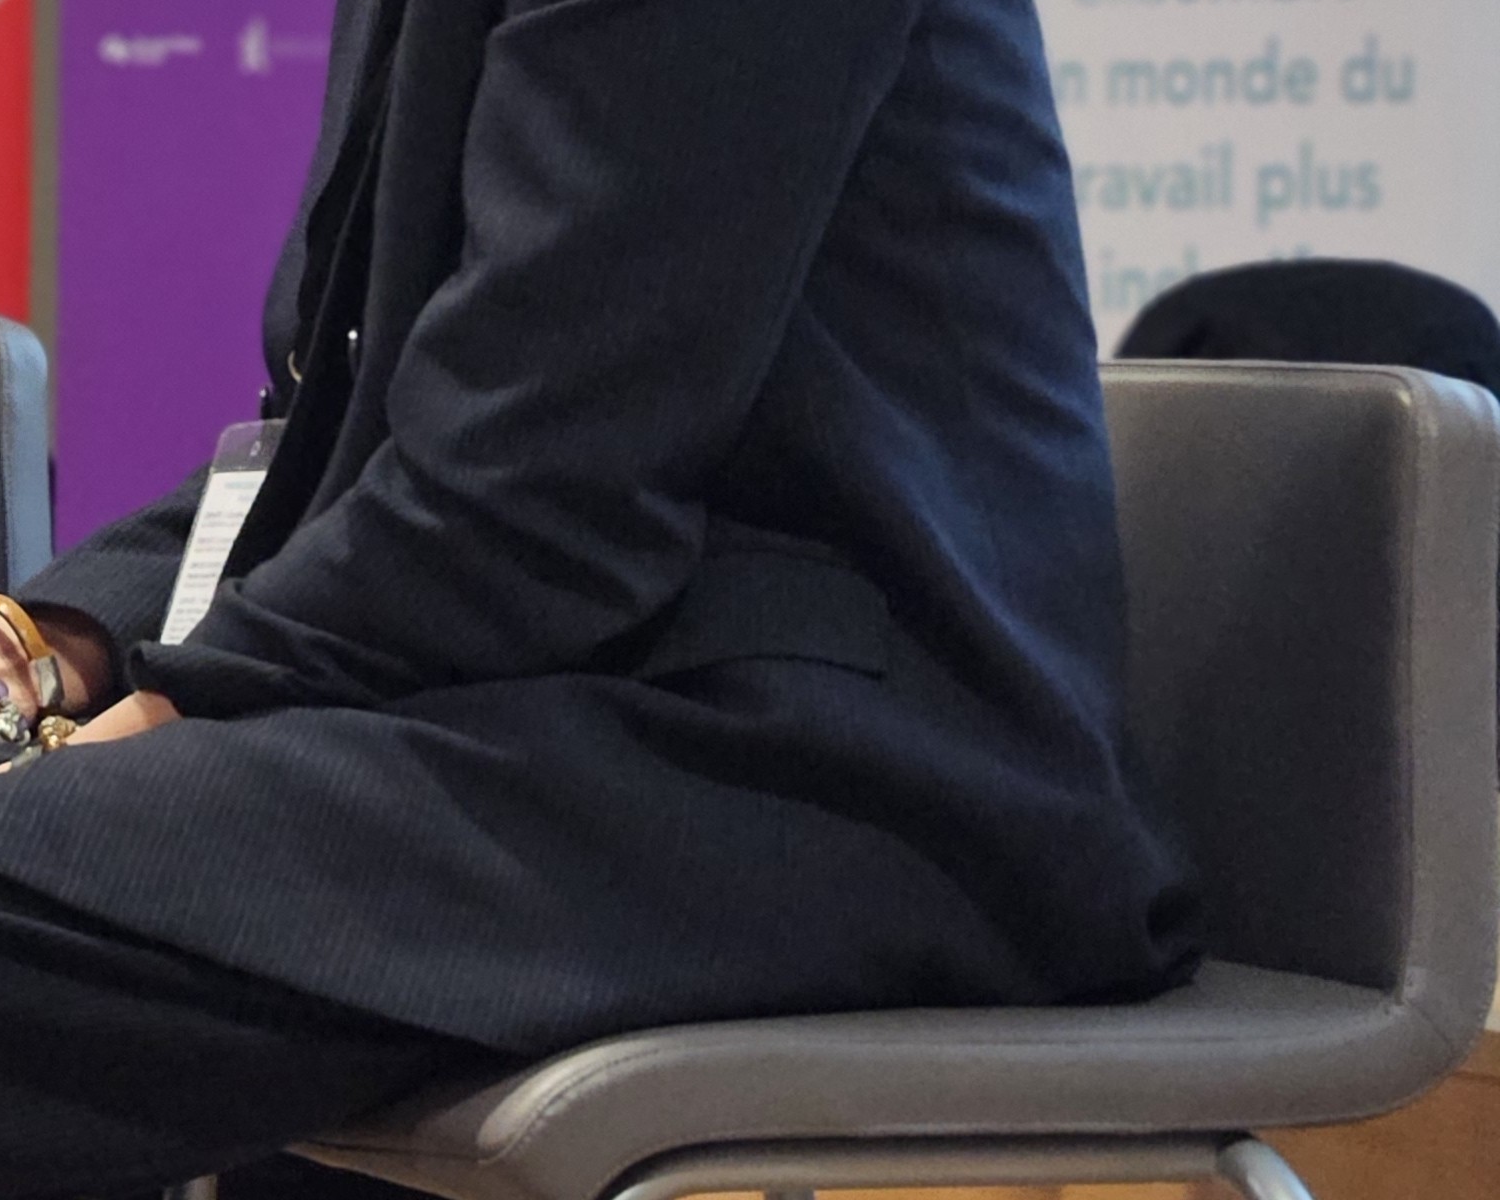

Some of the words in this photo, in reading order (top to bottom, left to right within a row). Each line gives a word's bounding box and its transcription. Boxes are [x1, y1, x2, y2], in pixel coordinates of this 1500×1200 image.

[1054, 59, 1088, 105] n
[1106, 35, 1320, 106] monde
[1340, 32, 1417, 104] du
[1073, 140, 1236, 211] ravail
[1256, 139, 1382, 231] plus
